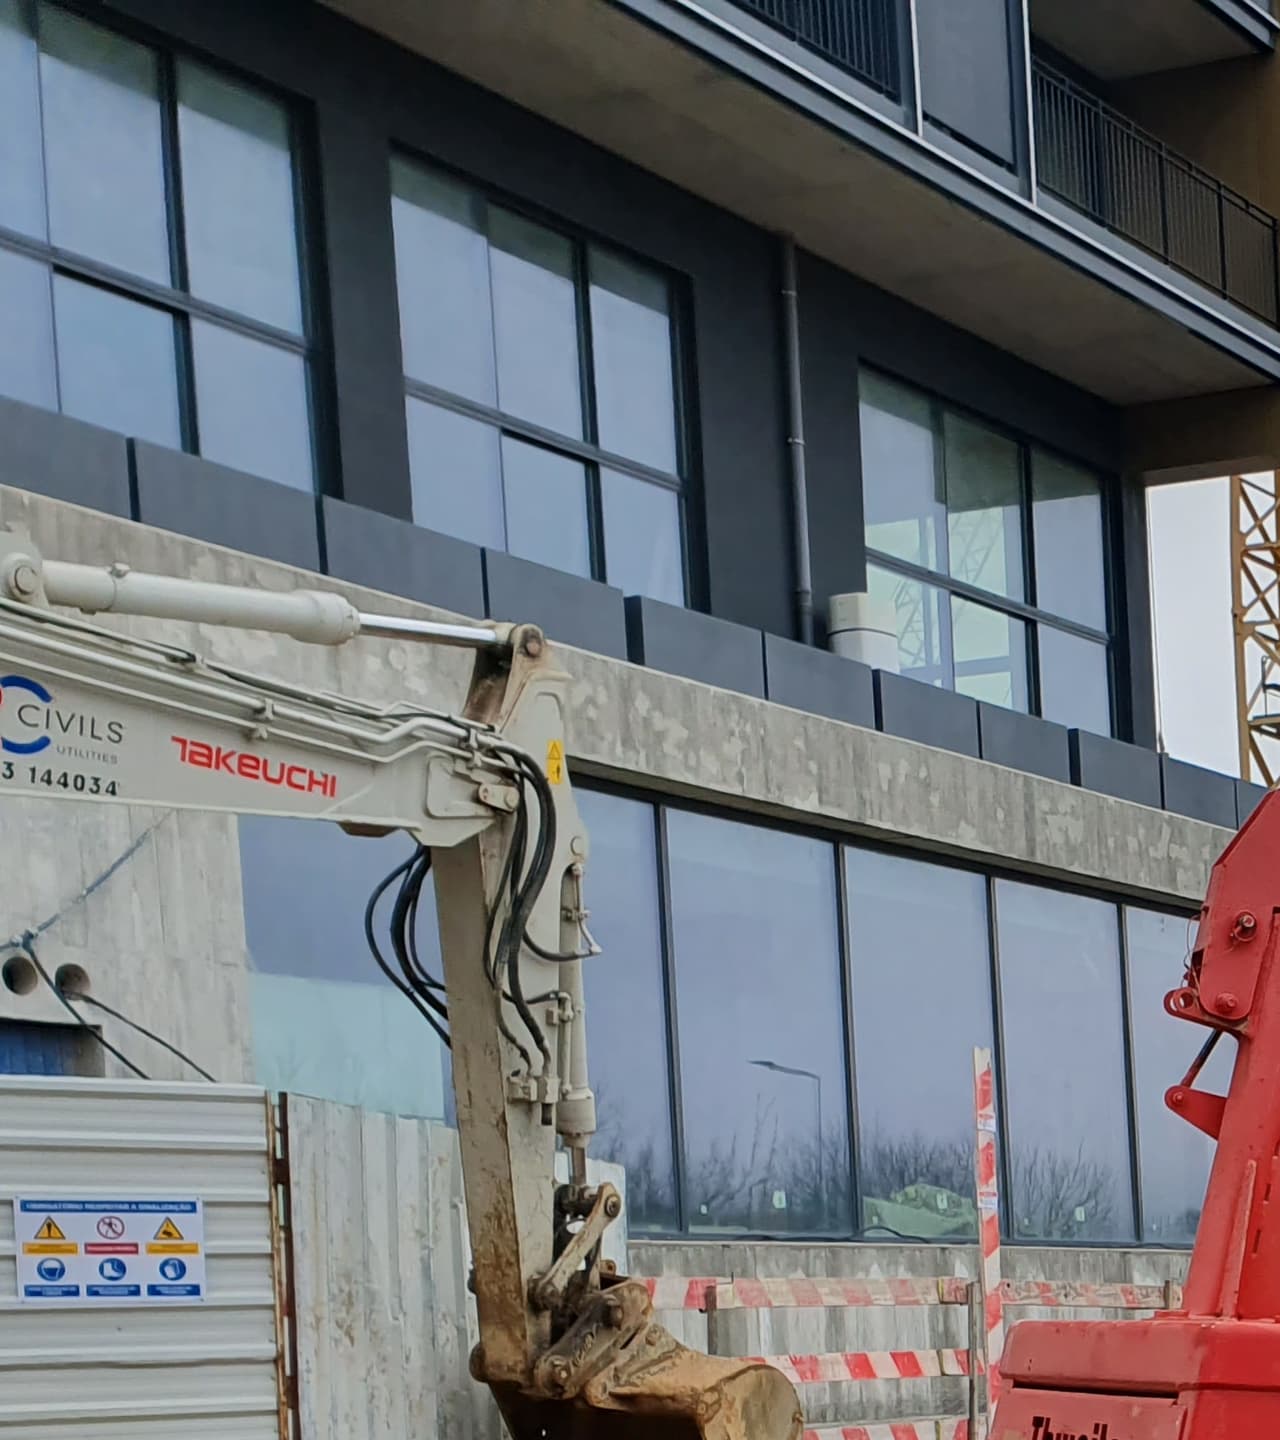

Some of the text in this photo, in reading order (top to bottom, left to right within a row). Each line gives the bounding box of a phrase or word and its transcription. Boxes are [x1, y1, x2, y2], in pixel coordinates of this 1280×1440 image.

[18, 704, 124, 743] CIVILS
[57, 744, 118, 764] UTILITIES
[171, 736, 337, 797] TAKEUCHI
[29, 766, 118, 796] 144034
